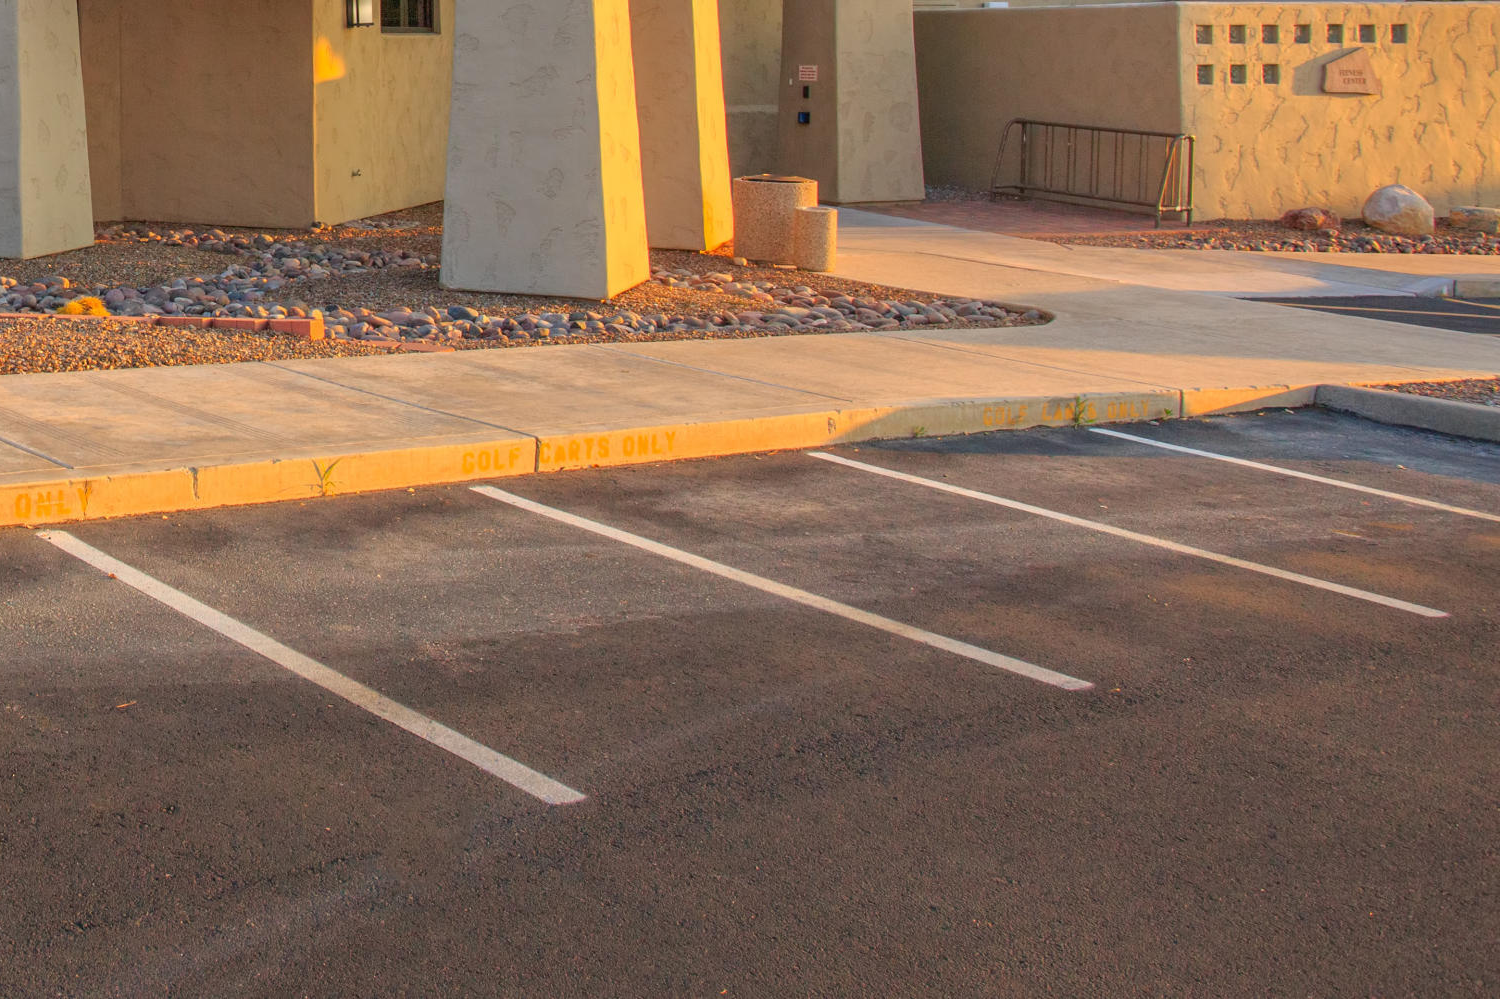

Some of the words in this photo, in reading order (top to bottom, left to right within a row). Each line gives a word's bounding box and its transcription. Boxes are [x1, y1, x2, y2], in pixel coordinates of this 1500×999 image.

[1343, 77, 1367, 85] CENTER
[983, 405, 1028, 427] GOLF
[1107, 399, 1150, 419] ONLY
[461, 446, 522, 475] GOLF
[538, 436, 610, 465] CARTS
[622, 431, 677, 457] ONLY
[15, 485, 93, 519] ONLY
